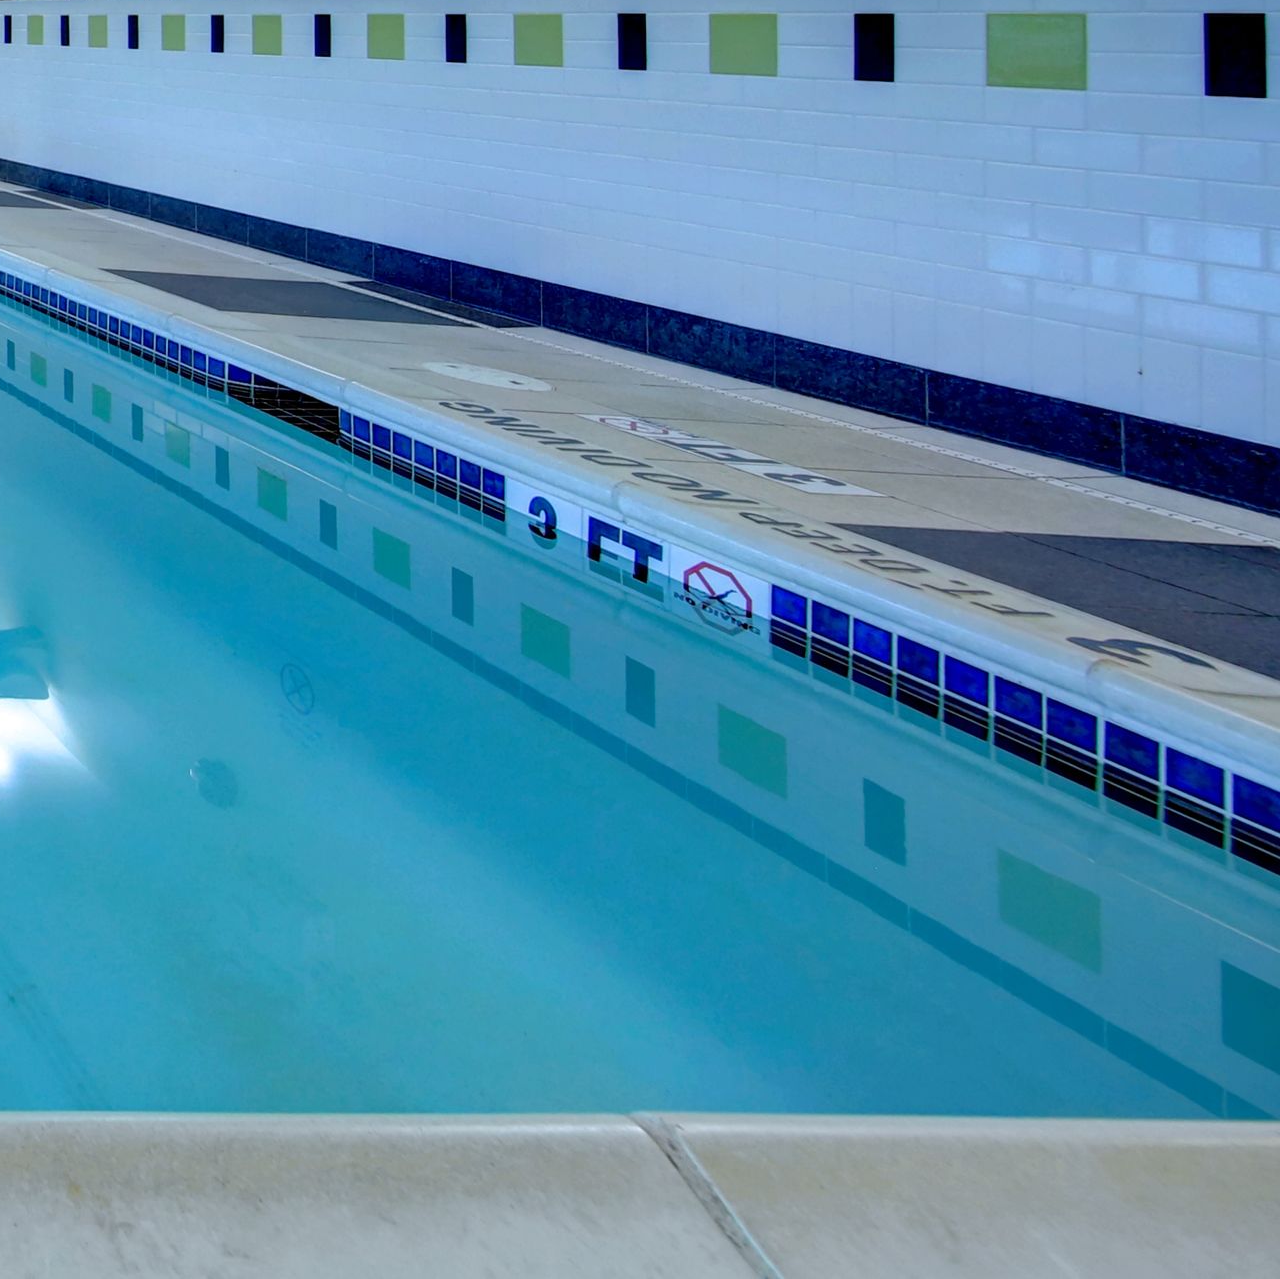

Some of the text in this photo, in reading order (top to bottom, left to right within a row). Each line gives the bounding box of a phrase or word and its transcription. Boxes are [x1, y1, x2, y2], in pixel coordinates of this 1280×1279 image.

[438, 400, 654, 468] DIVING
[630, 471, 761, 505] NO
[587, 515, 664, 584] FT
[738, 511, 931, 574] DEEP
